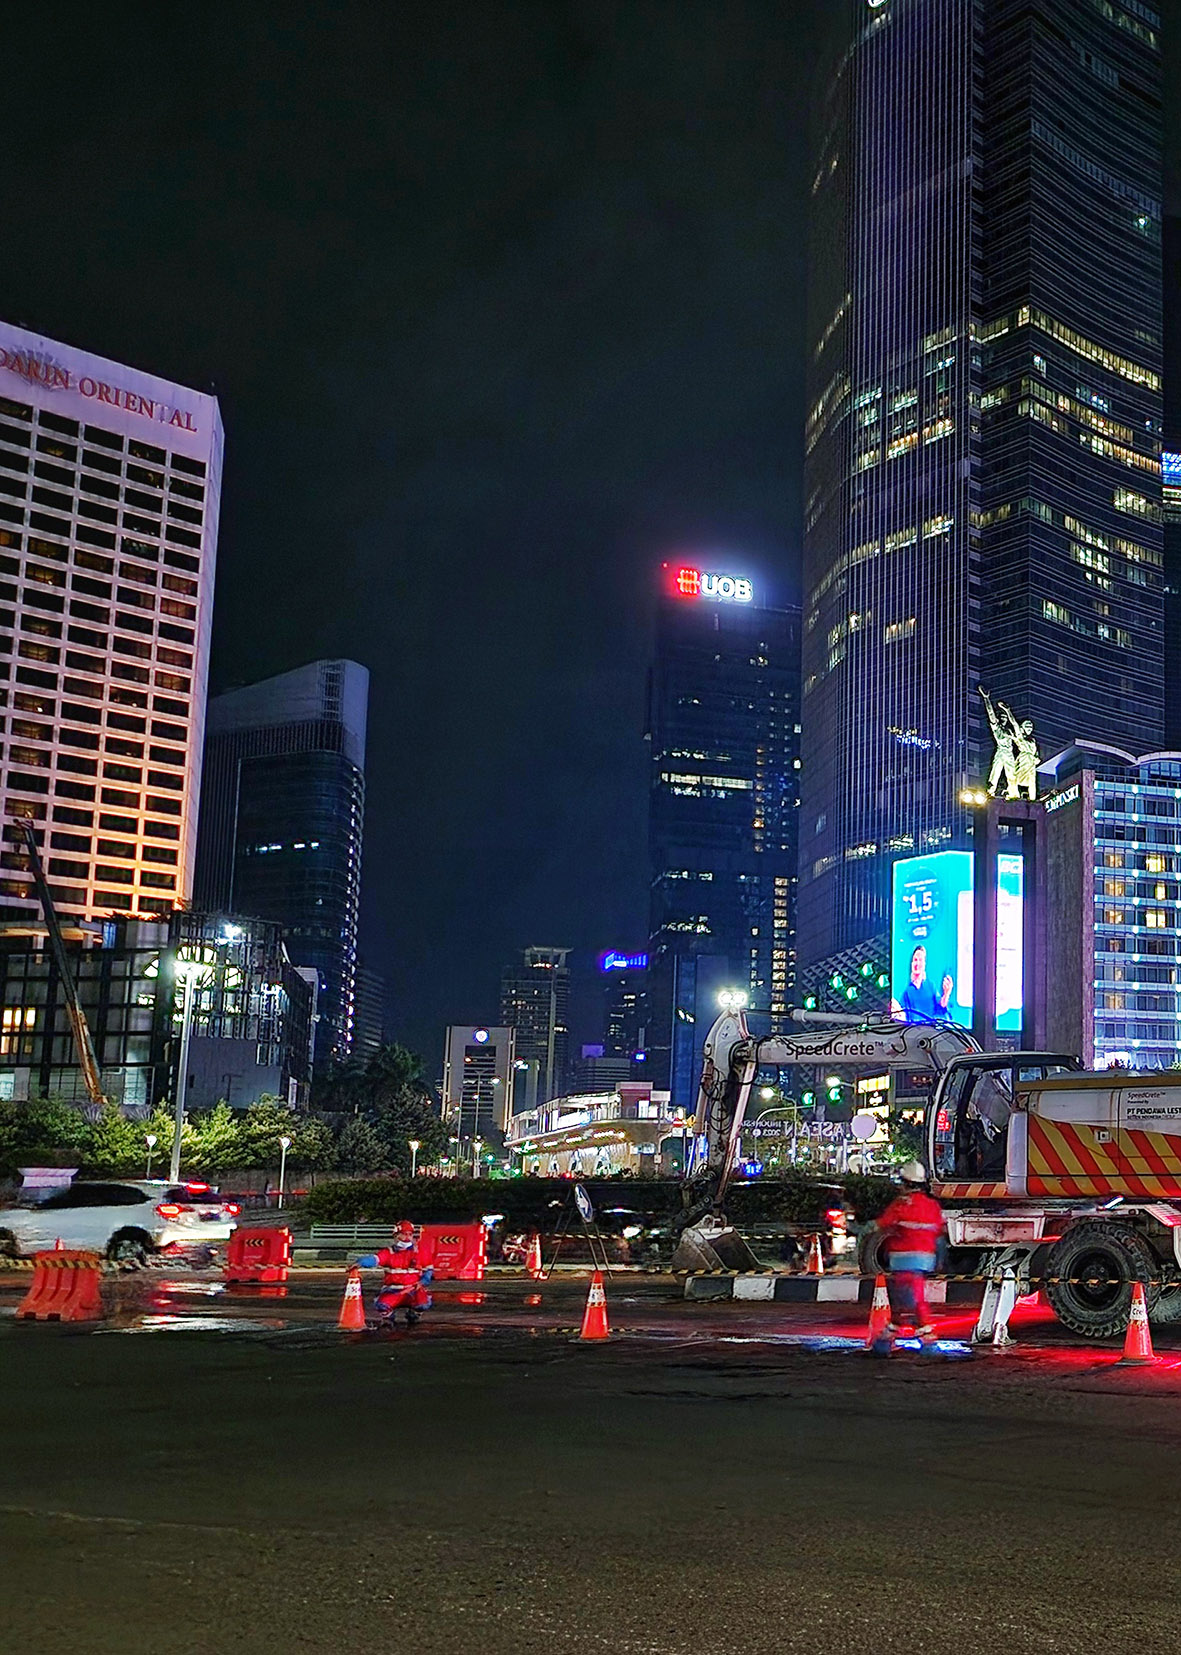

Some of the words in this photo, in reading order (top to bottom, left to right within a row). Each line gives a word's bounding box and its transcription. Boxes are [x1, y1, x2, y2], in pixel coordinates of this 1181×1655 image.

[79, 376, 198, 433] ORIENTAL
[700, 572, 753, 602] UOB
[1126, 1107, 1135, 1115] PT
